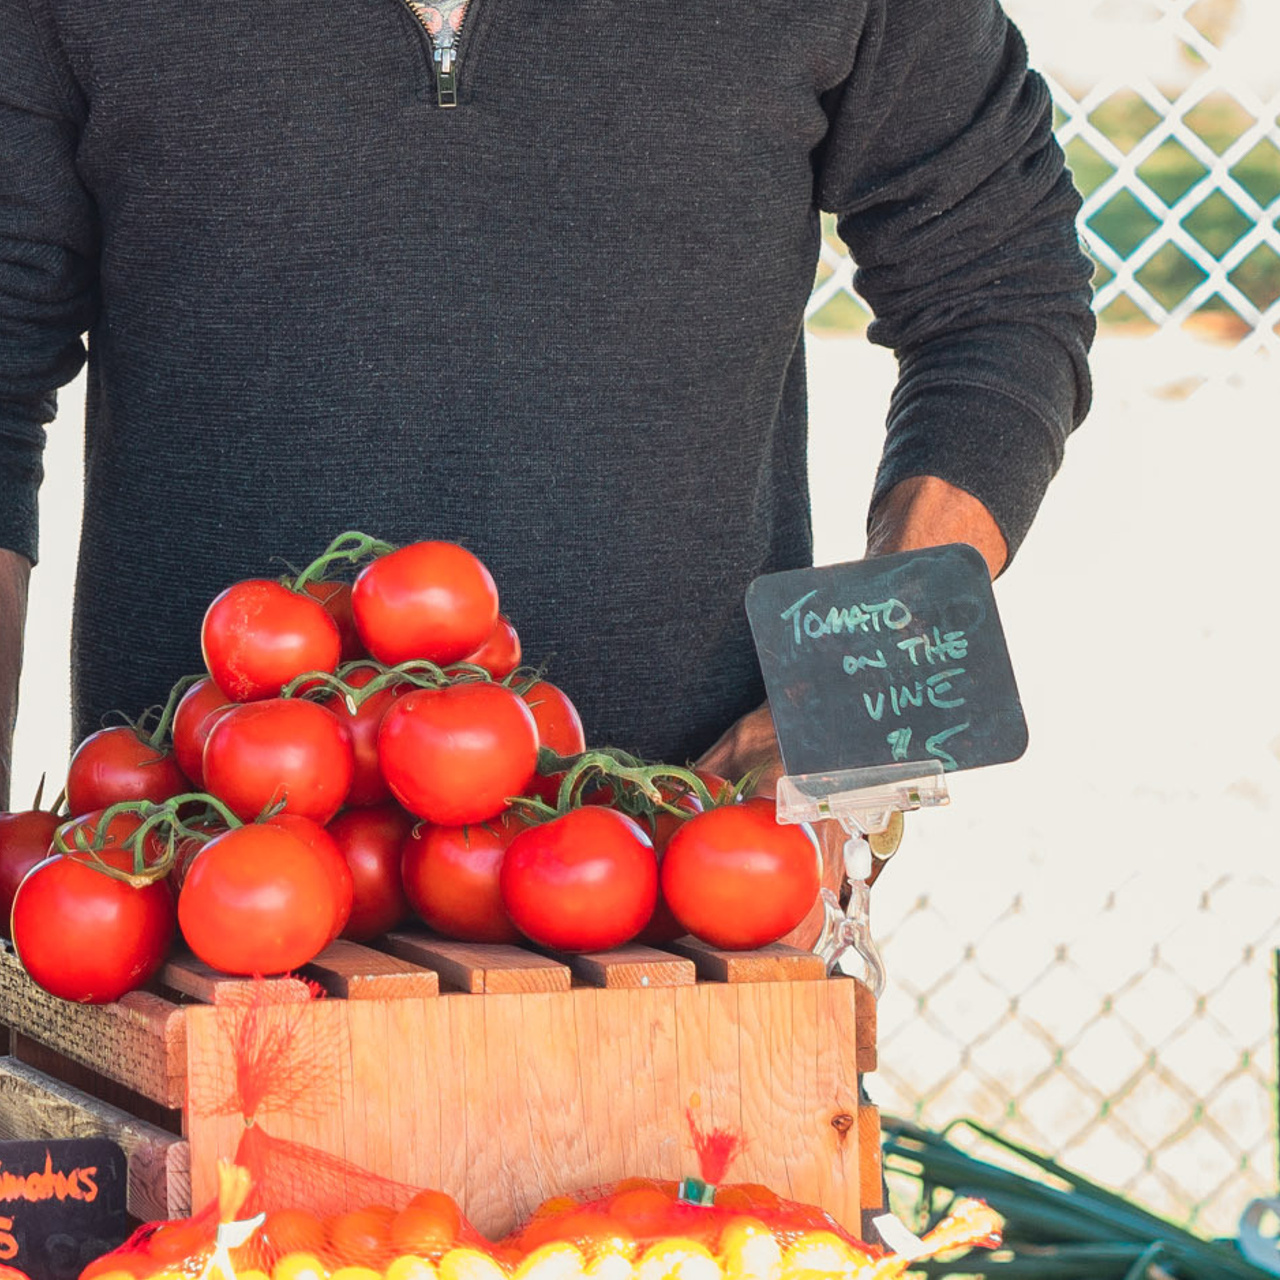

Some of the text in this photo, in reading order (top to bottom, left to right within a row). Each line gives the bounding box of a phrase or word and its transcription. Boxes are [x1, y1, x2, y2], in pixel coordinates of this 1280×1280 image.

[781, 590, 912, 645] TOMATO
[897, 626, 969, 666] THE
[863, 668, 966, 721] VINE
